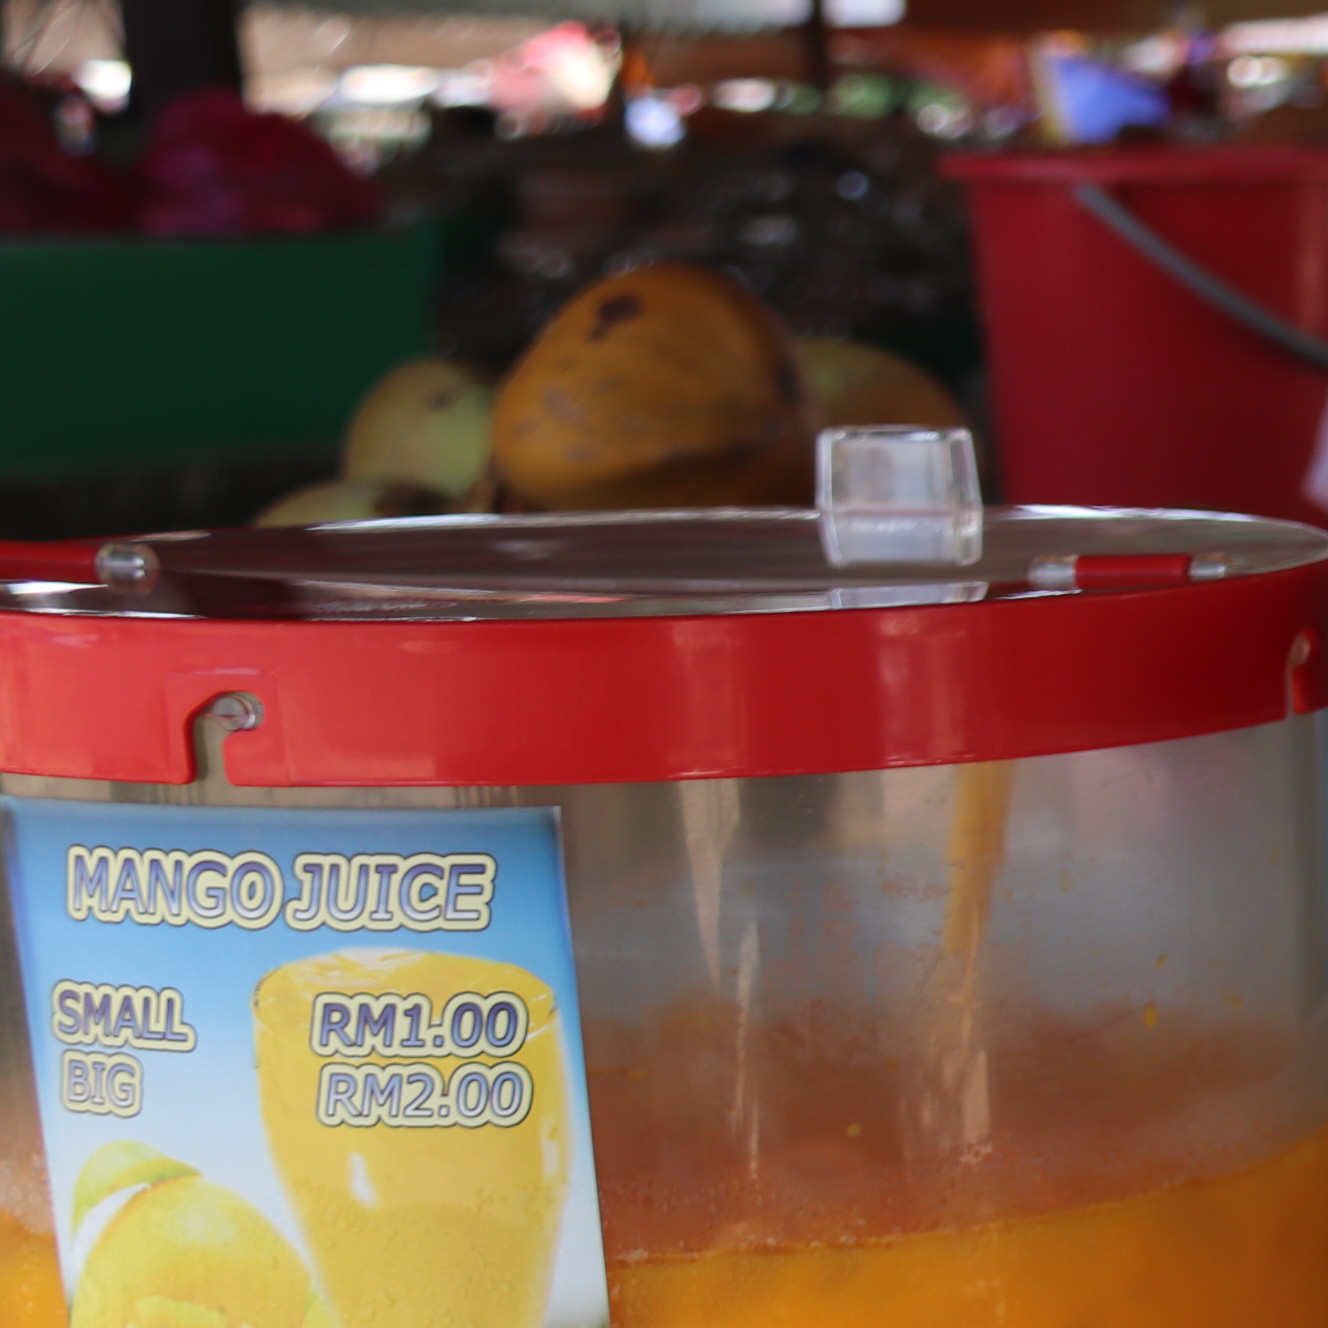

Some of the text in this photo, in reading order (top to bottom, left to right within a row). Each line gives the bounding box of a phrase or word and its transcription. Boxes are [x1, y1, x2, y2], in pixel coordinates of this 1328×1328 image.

[70, 849, 492, 927] MANGO JUICE
[55, 984, 523, 1052] SMALL RM1.00
[65, 1054, 528, 1122] BIG RM2.00
